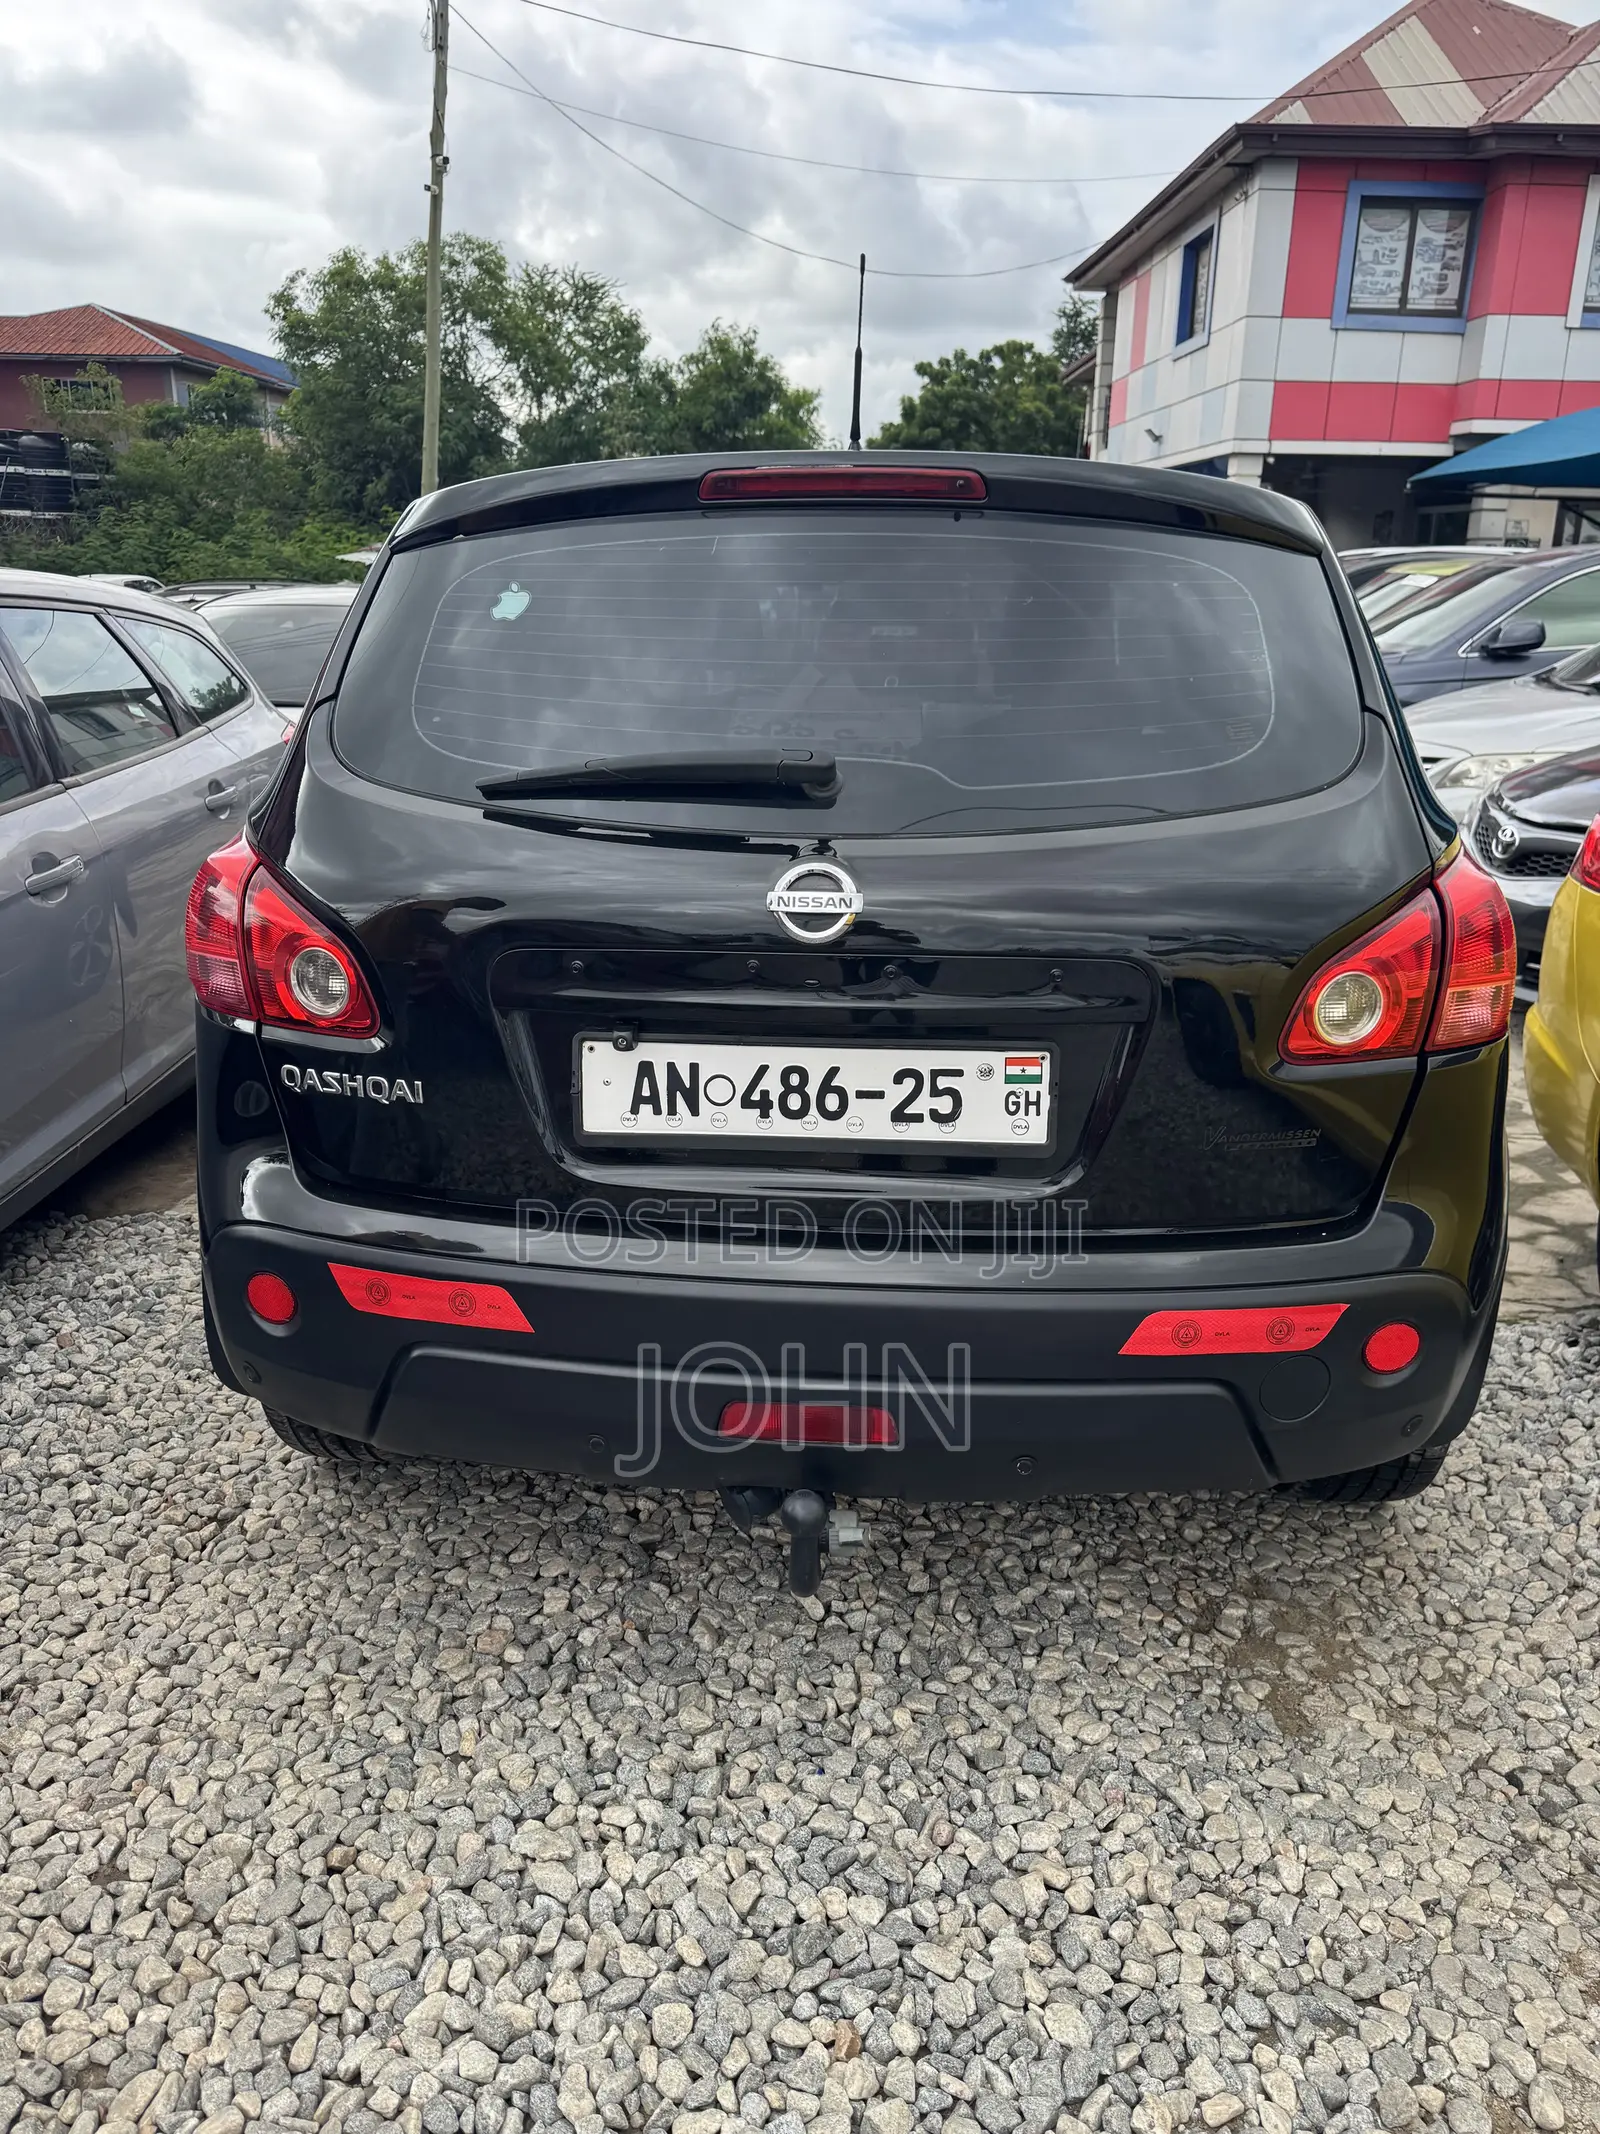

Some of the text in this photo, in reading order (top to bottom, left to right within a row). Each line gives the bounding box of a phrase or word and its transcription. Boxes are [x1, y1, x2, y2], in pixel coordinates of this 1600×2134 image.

[777, 896, 853, 909] NISSAN
[280, 1064, 424, 1104] QASHQAI
[629, 1060, 965, 1124] AN 486-25
[1004, 1090, 1041, 1117] GH
